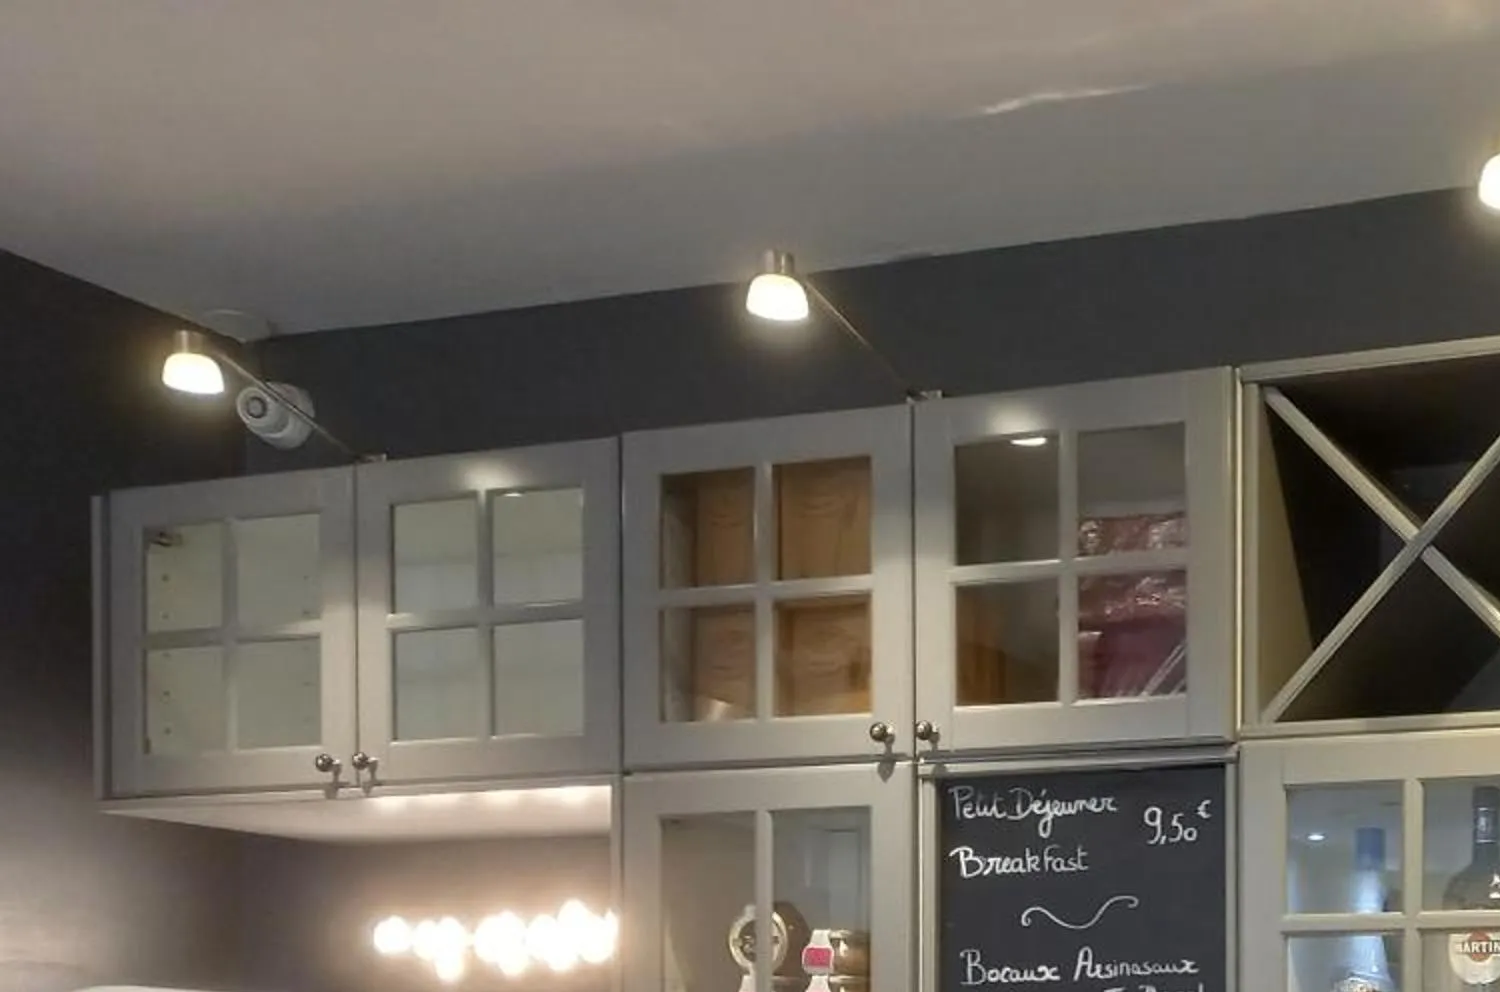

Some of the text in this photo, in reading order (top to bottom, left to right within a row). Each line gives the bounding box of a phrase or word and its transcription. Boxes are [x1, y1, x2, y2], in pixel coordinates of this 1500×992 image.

[948, 785, 1006, 820] Petit
[1008, 787, 1118, 838] Déjeuner
[949, 845, 1089, 878] Breakfast
